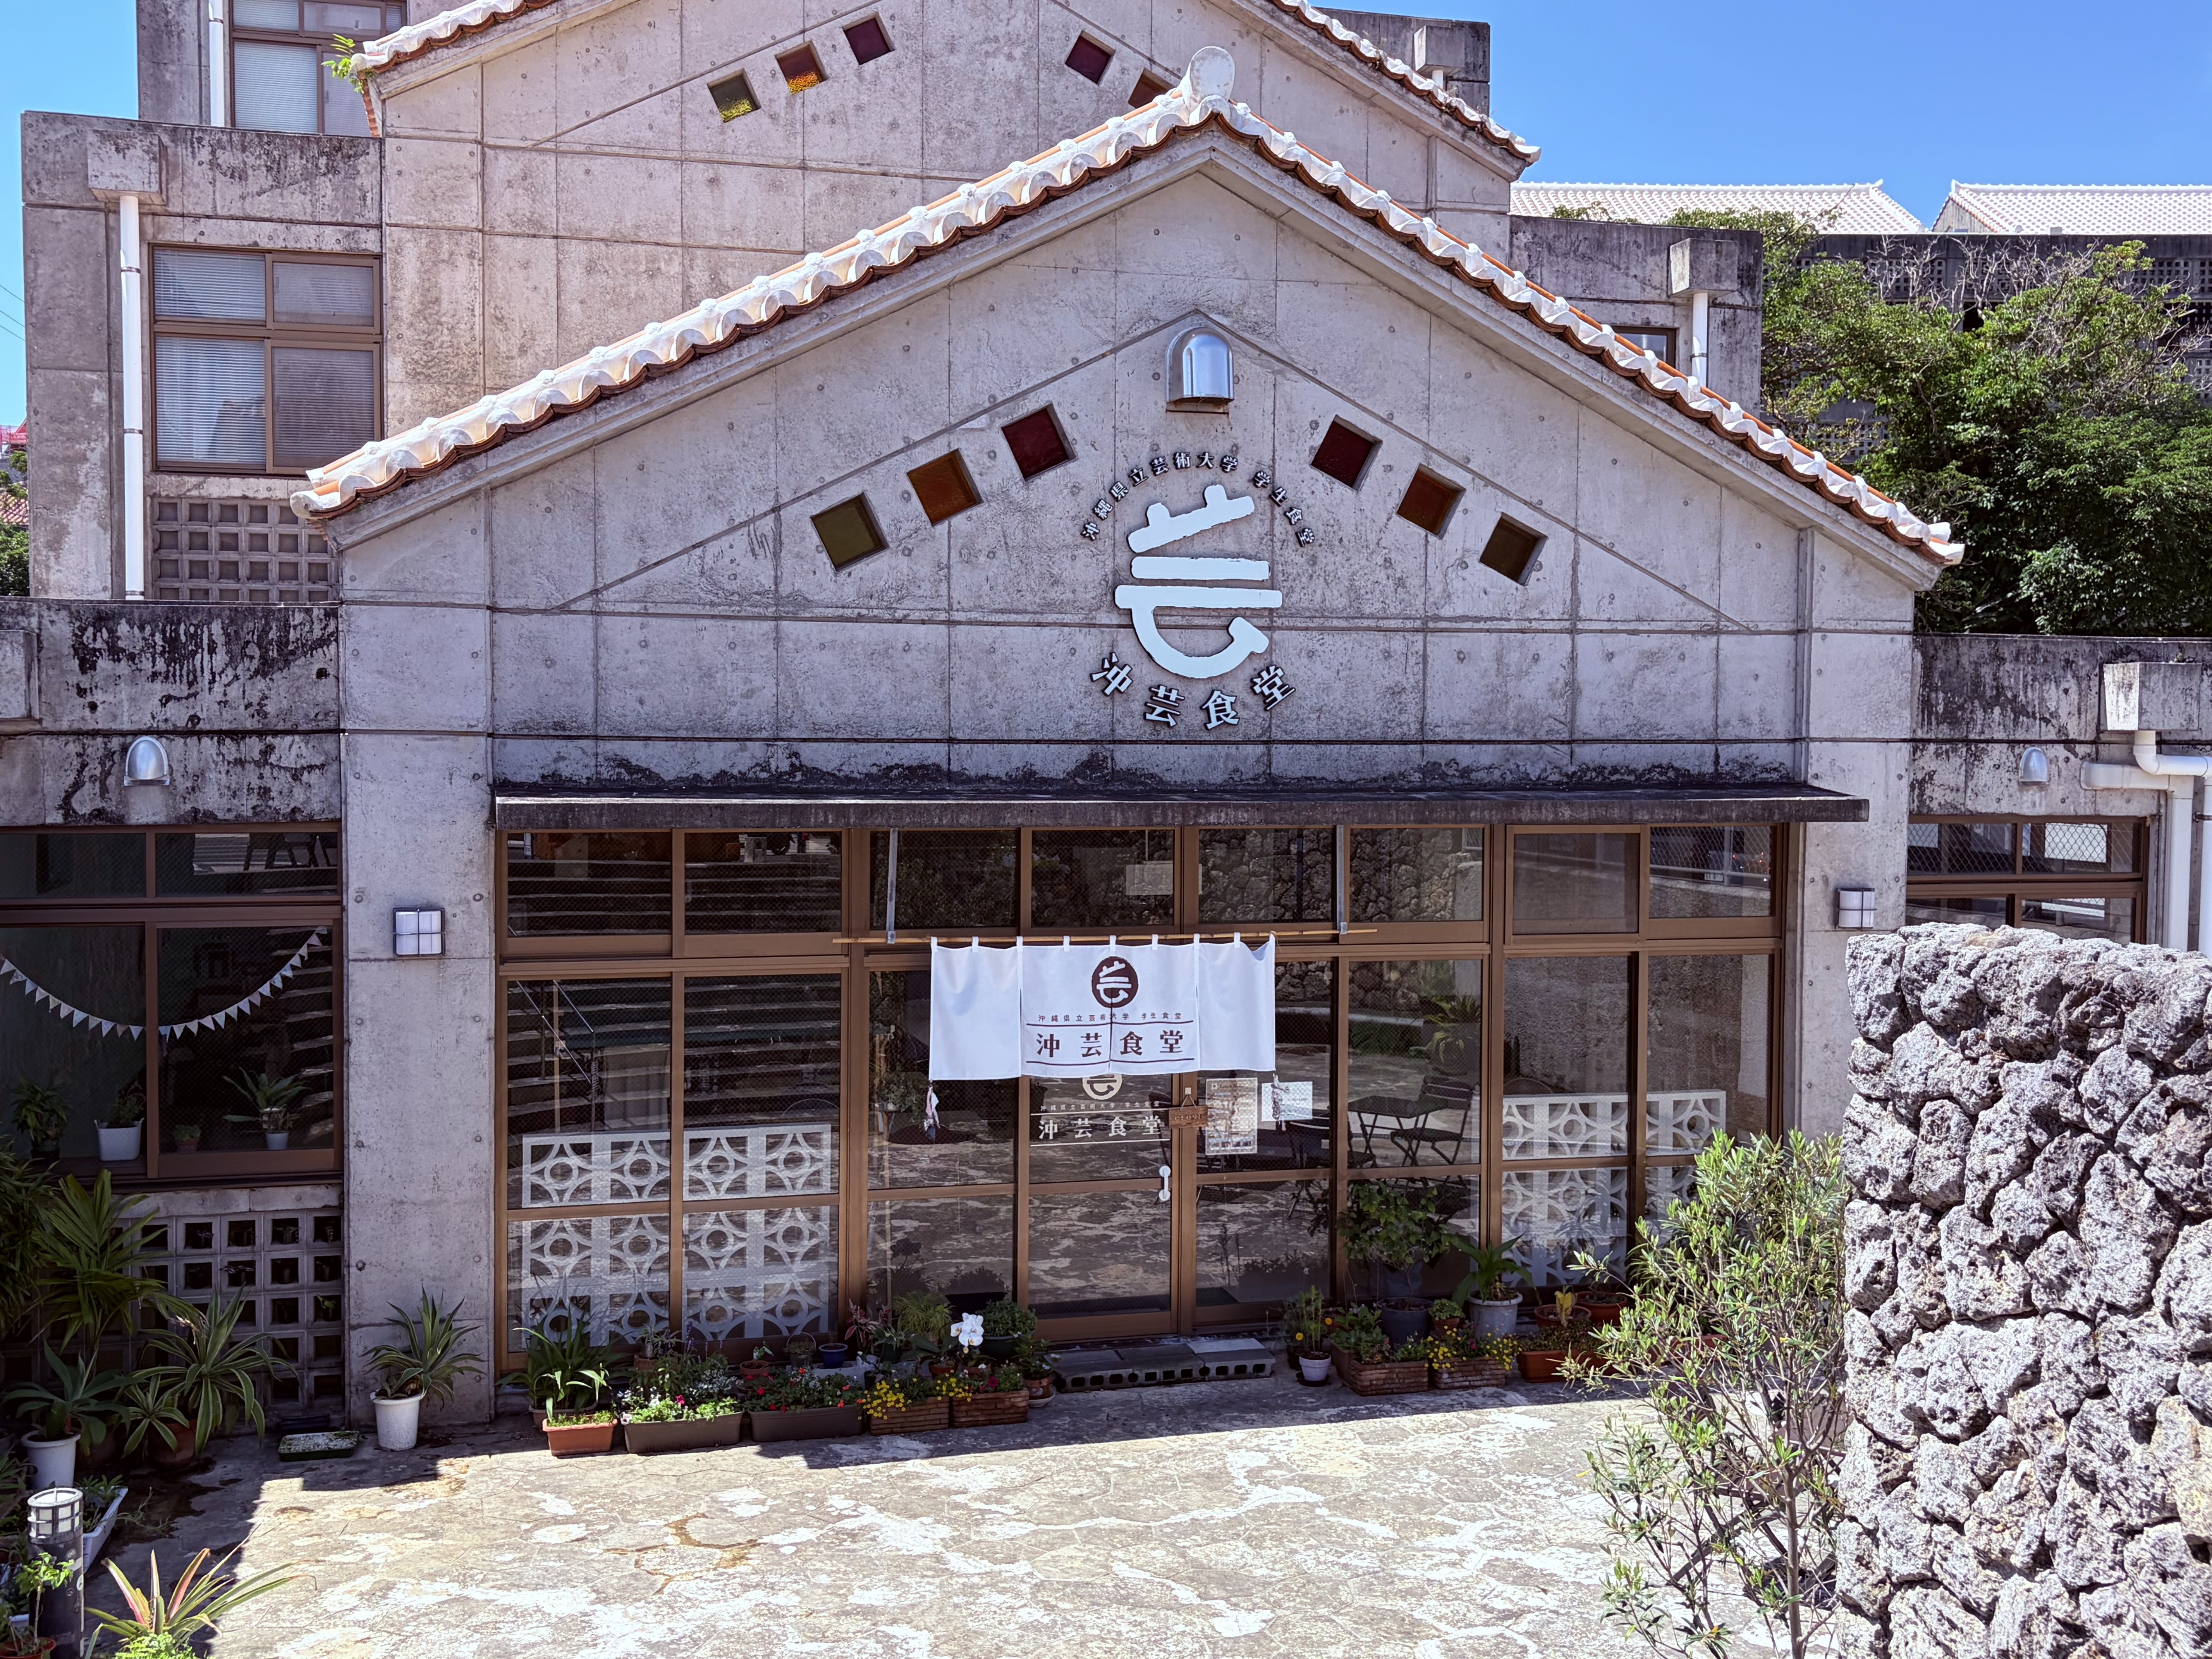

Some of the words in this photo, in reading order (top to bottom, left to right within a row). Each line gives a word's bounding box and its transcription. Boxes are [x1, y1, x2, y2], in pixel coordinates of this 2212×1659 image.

[1081, 452, 1238, 541] 沖縄県立芸術大学
[1253, 470, 1315, 547] 学生食堂
[1090, 652, 1296, 730] 沖芸食堂
[1141, 1012, 1182, 1020] 学生食堂
[1036, 1030, 1183, 1058] 沖芸食堂
[1039, 1115, 1161, 1140] 沖芸食堂
